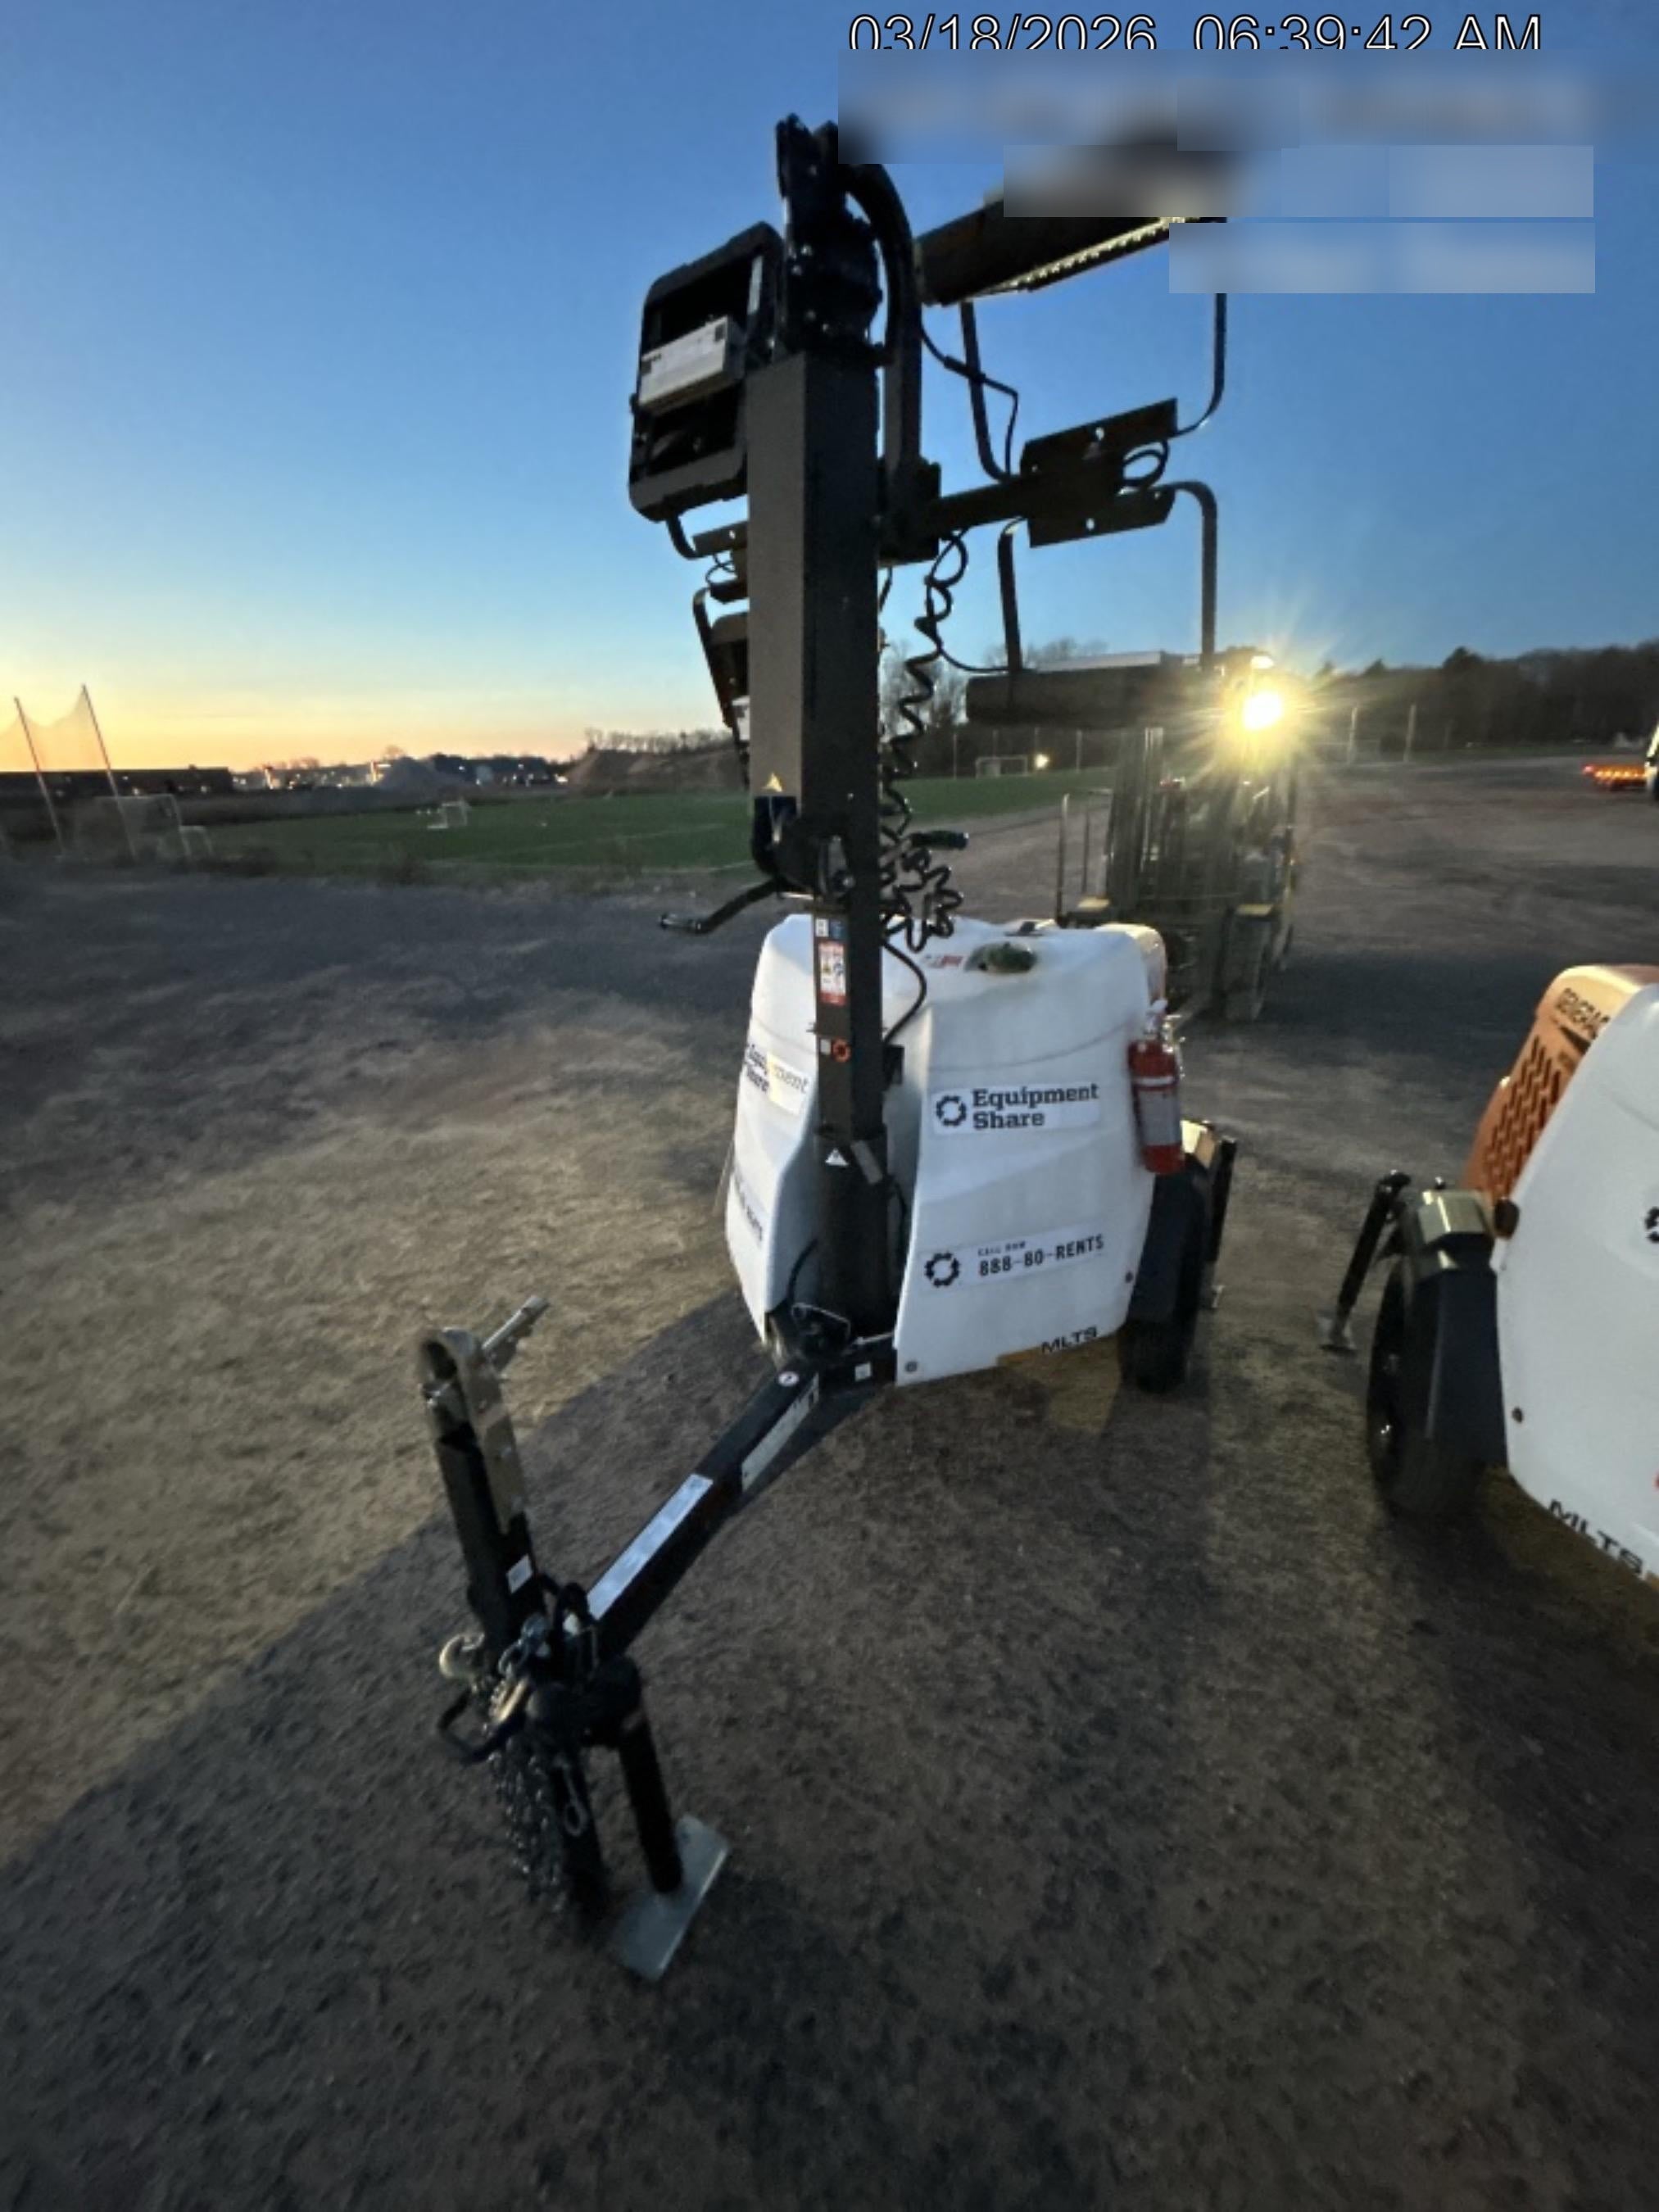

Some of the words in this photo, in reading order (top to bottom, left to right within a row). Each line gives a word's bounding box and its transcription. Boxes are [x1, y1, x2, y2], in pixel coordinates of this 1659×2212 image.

[972, 1083, 1099, 1109] Equipment
[973, 1111, 1045, 1130] Share
[979, 1234, 1104, 1276] 888-80-RENTS
